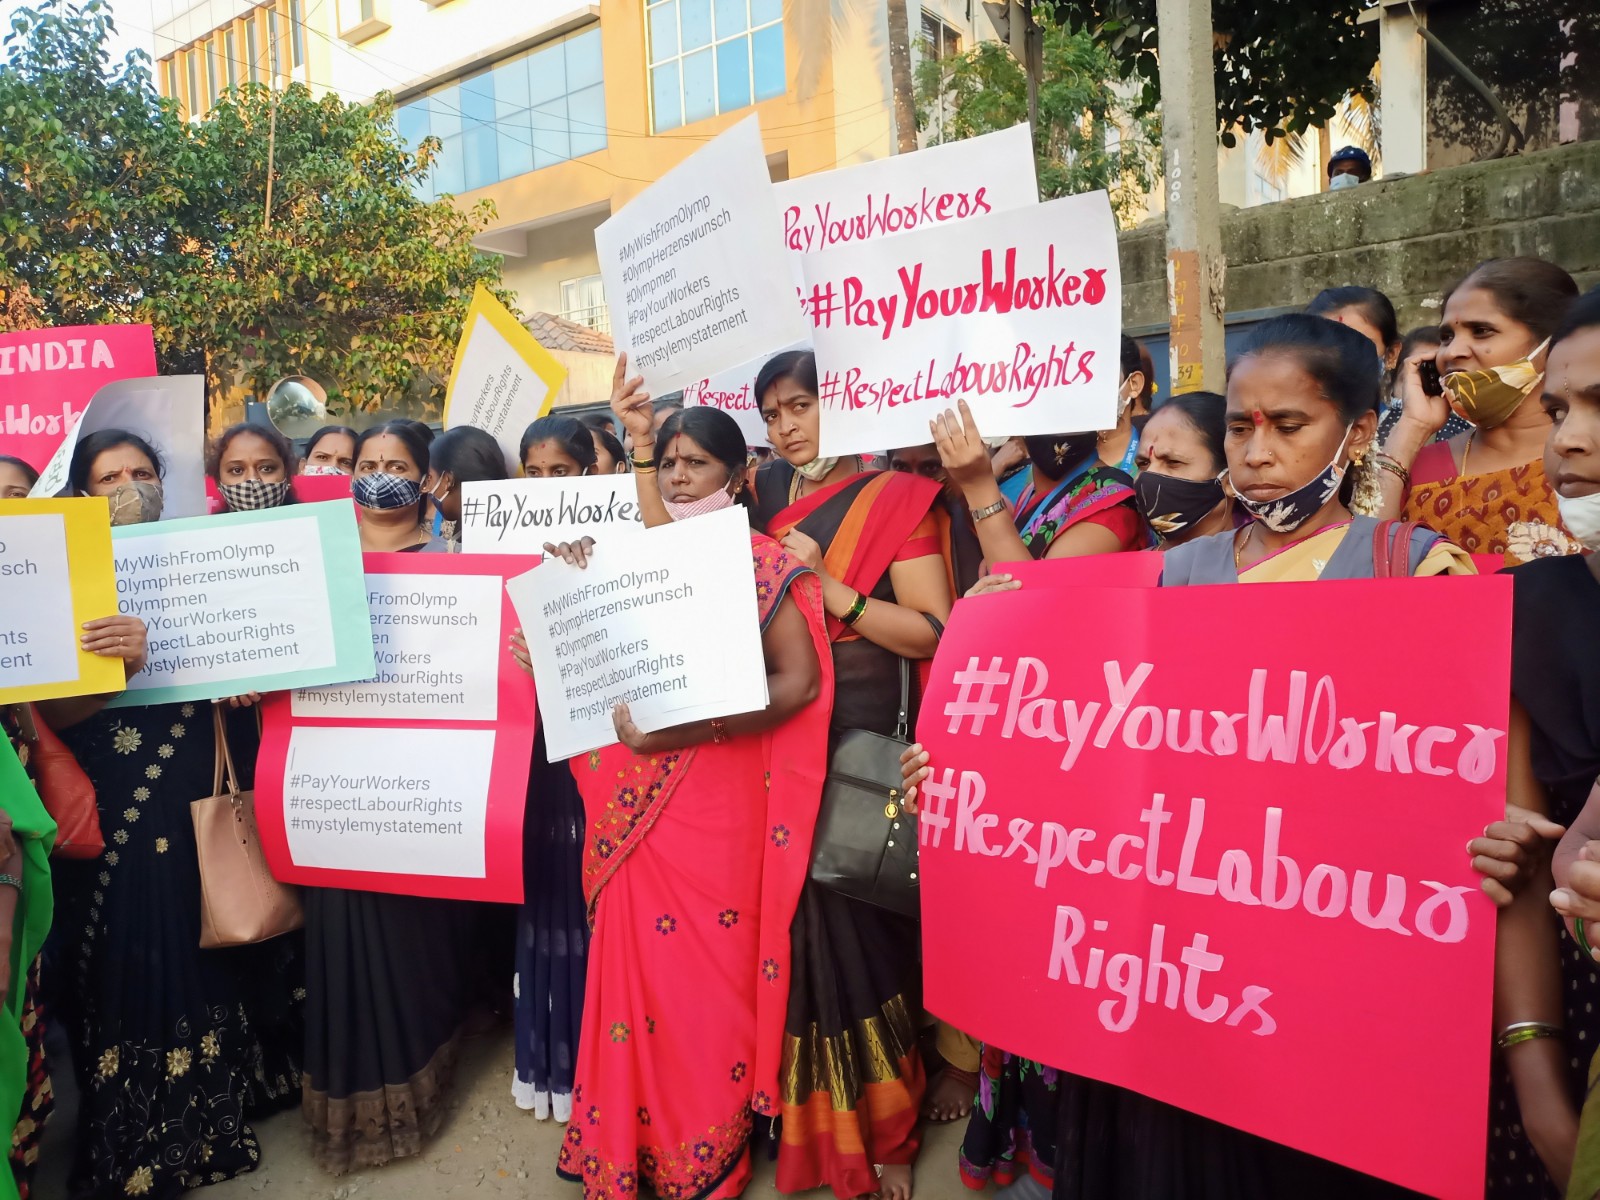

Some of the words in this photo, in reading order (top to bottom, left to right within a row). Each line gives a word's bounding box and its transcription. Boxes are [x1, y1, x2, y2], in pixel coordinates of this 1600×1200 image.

[619, 195, 711, 263] #MyWishFromOlymp
[622, 207, 731, 284] #OlympHerzenswunsch
[626, 267, 677, 306] #Olympmen
[628, 275, 711, 327] #PayYourWorkers
[808, 244, 1107, 340] #PayYourWorker
[632, 287, 740, 348] #respectLabourRights
[635, 308, 748, 369] #mystylemystatement
[0, 339, 115, 375] INDIA
[821, 341, 1095, 414] #RespectLabourRights
[543, 568, 670, 618] #MyWishFromOlymp
[549, 583, 693, 638] #OlympHerzenswunsch
[555, 627, 608, 658] #Olympmen
[559, 638, 649, 681] #PayYourWorkers
[297, 690, 465, 706] #mystylemystatement
[565, 653, 685, 700] #respectLabourRights
[290, 774, 431, 792] #PayYourWorkers
[290, 796, 463, 815] #respectLabourRights
[290, 817, 463, 835] #mystylemystatement
[920, 766, 1478, 943] #RespectLabour
[1047, 903, 1277, 1036] Rights
